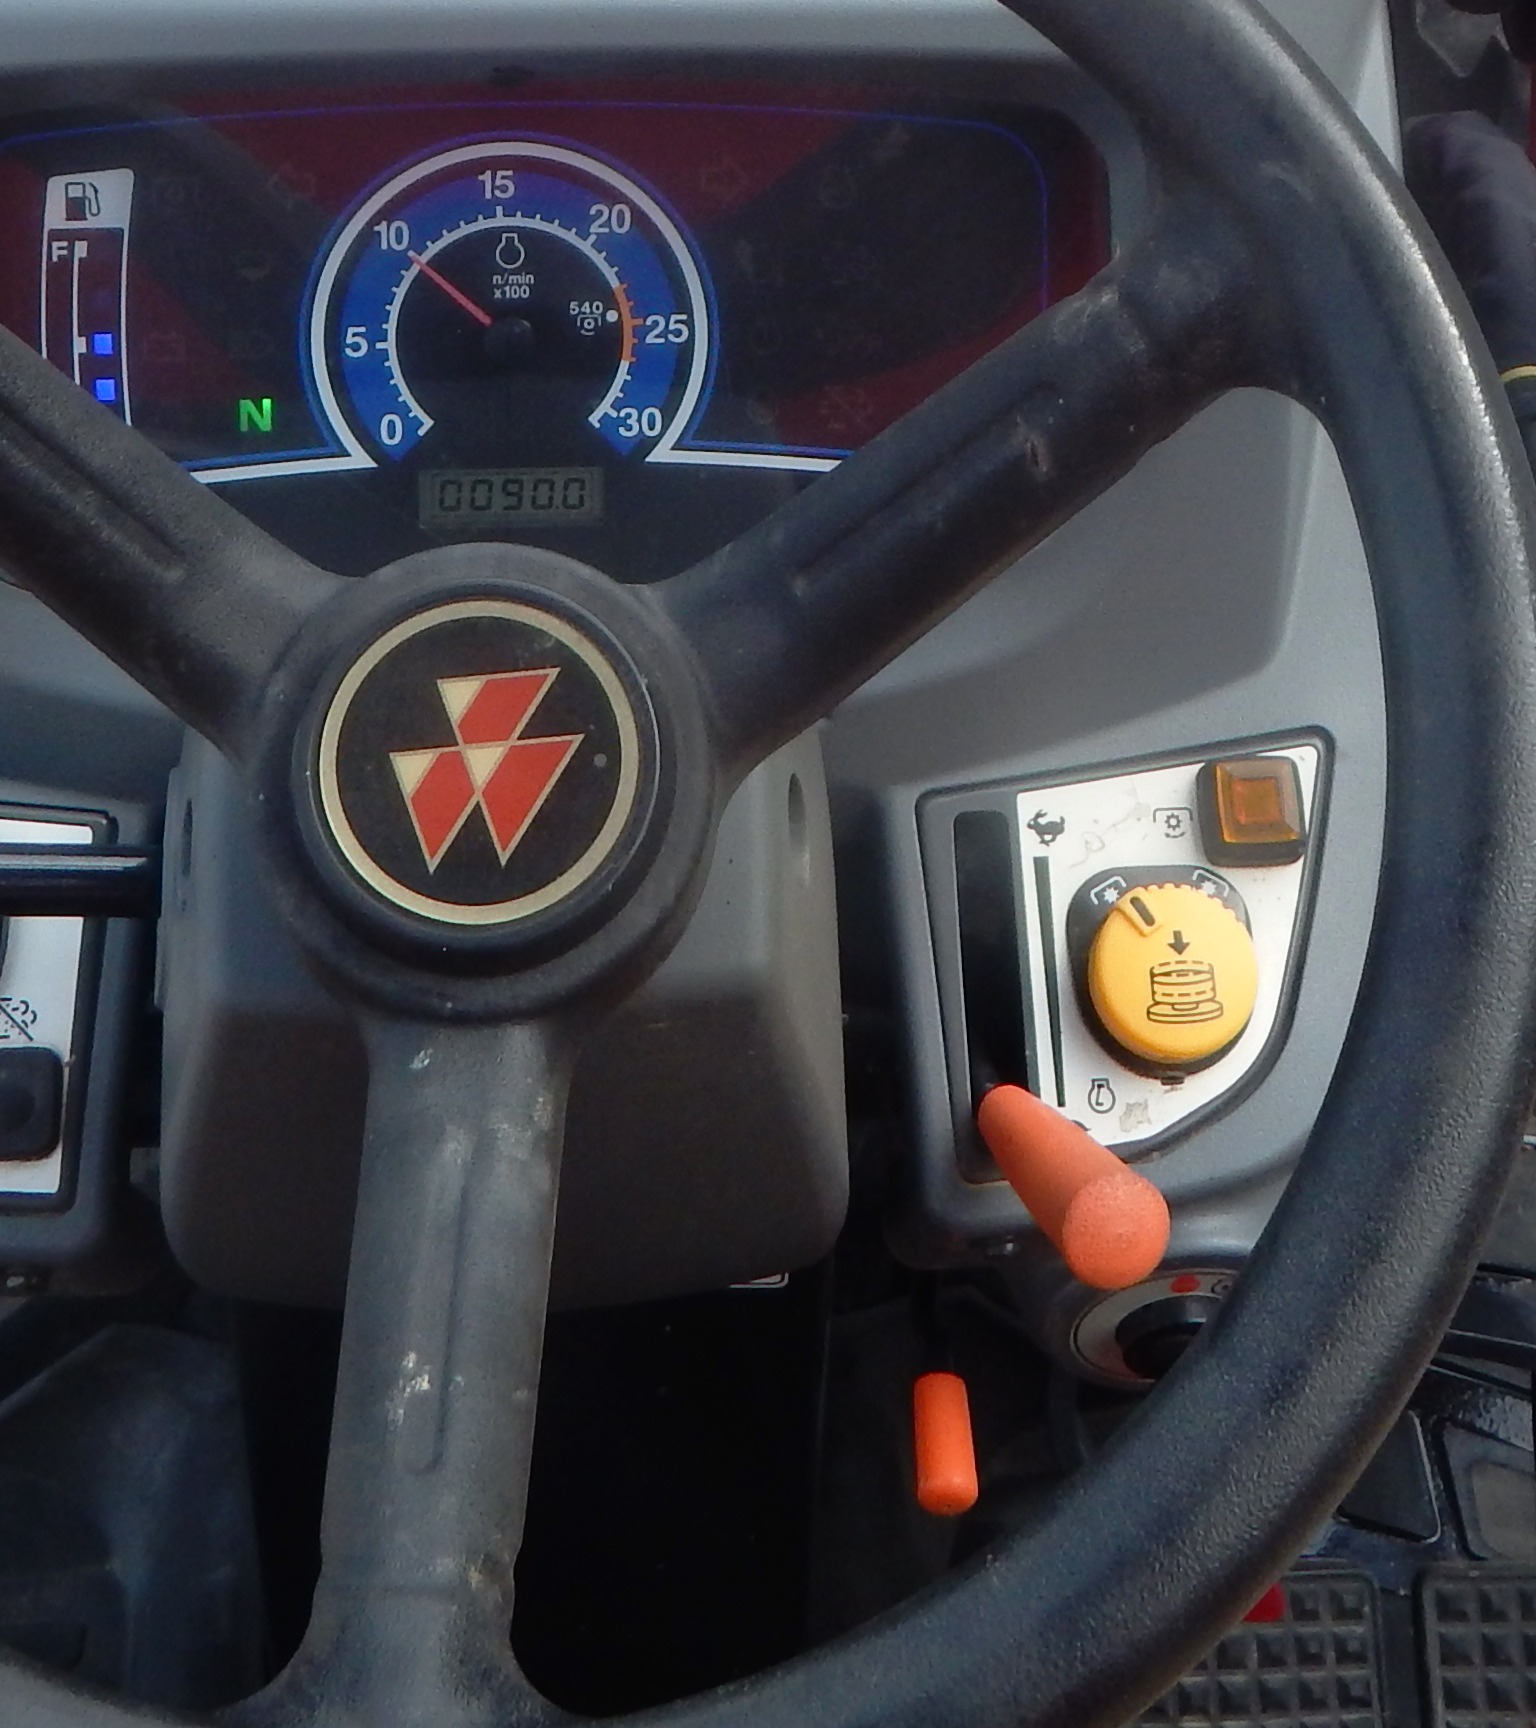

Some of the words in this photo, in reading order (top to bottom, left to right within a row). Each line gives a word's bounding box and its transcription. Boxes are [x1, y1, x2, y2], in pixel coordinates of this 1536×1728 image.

[477, 169, 515, 200] 15
[588, 203, 632, 235] 20
[51, 240, 69, 263] F
[374, 220, 410, 252] 10
[492, 273, 535, 285] n/min
[493, 285, 530, 299] x100
[569, 301, 603, 315] 540
[344, 327, 369, 358] 5
[644, 314, 689, 345] 25
[238, 398, 272, 433] N
[379, 414, 403, 446] 0
[617, 407, 662, 437] 30
